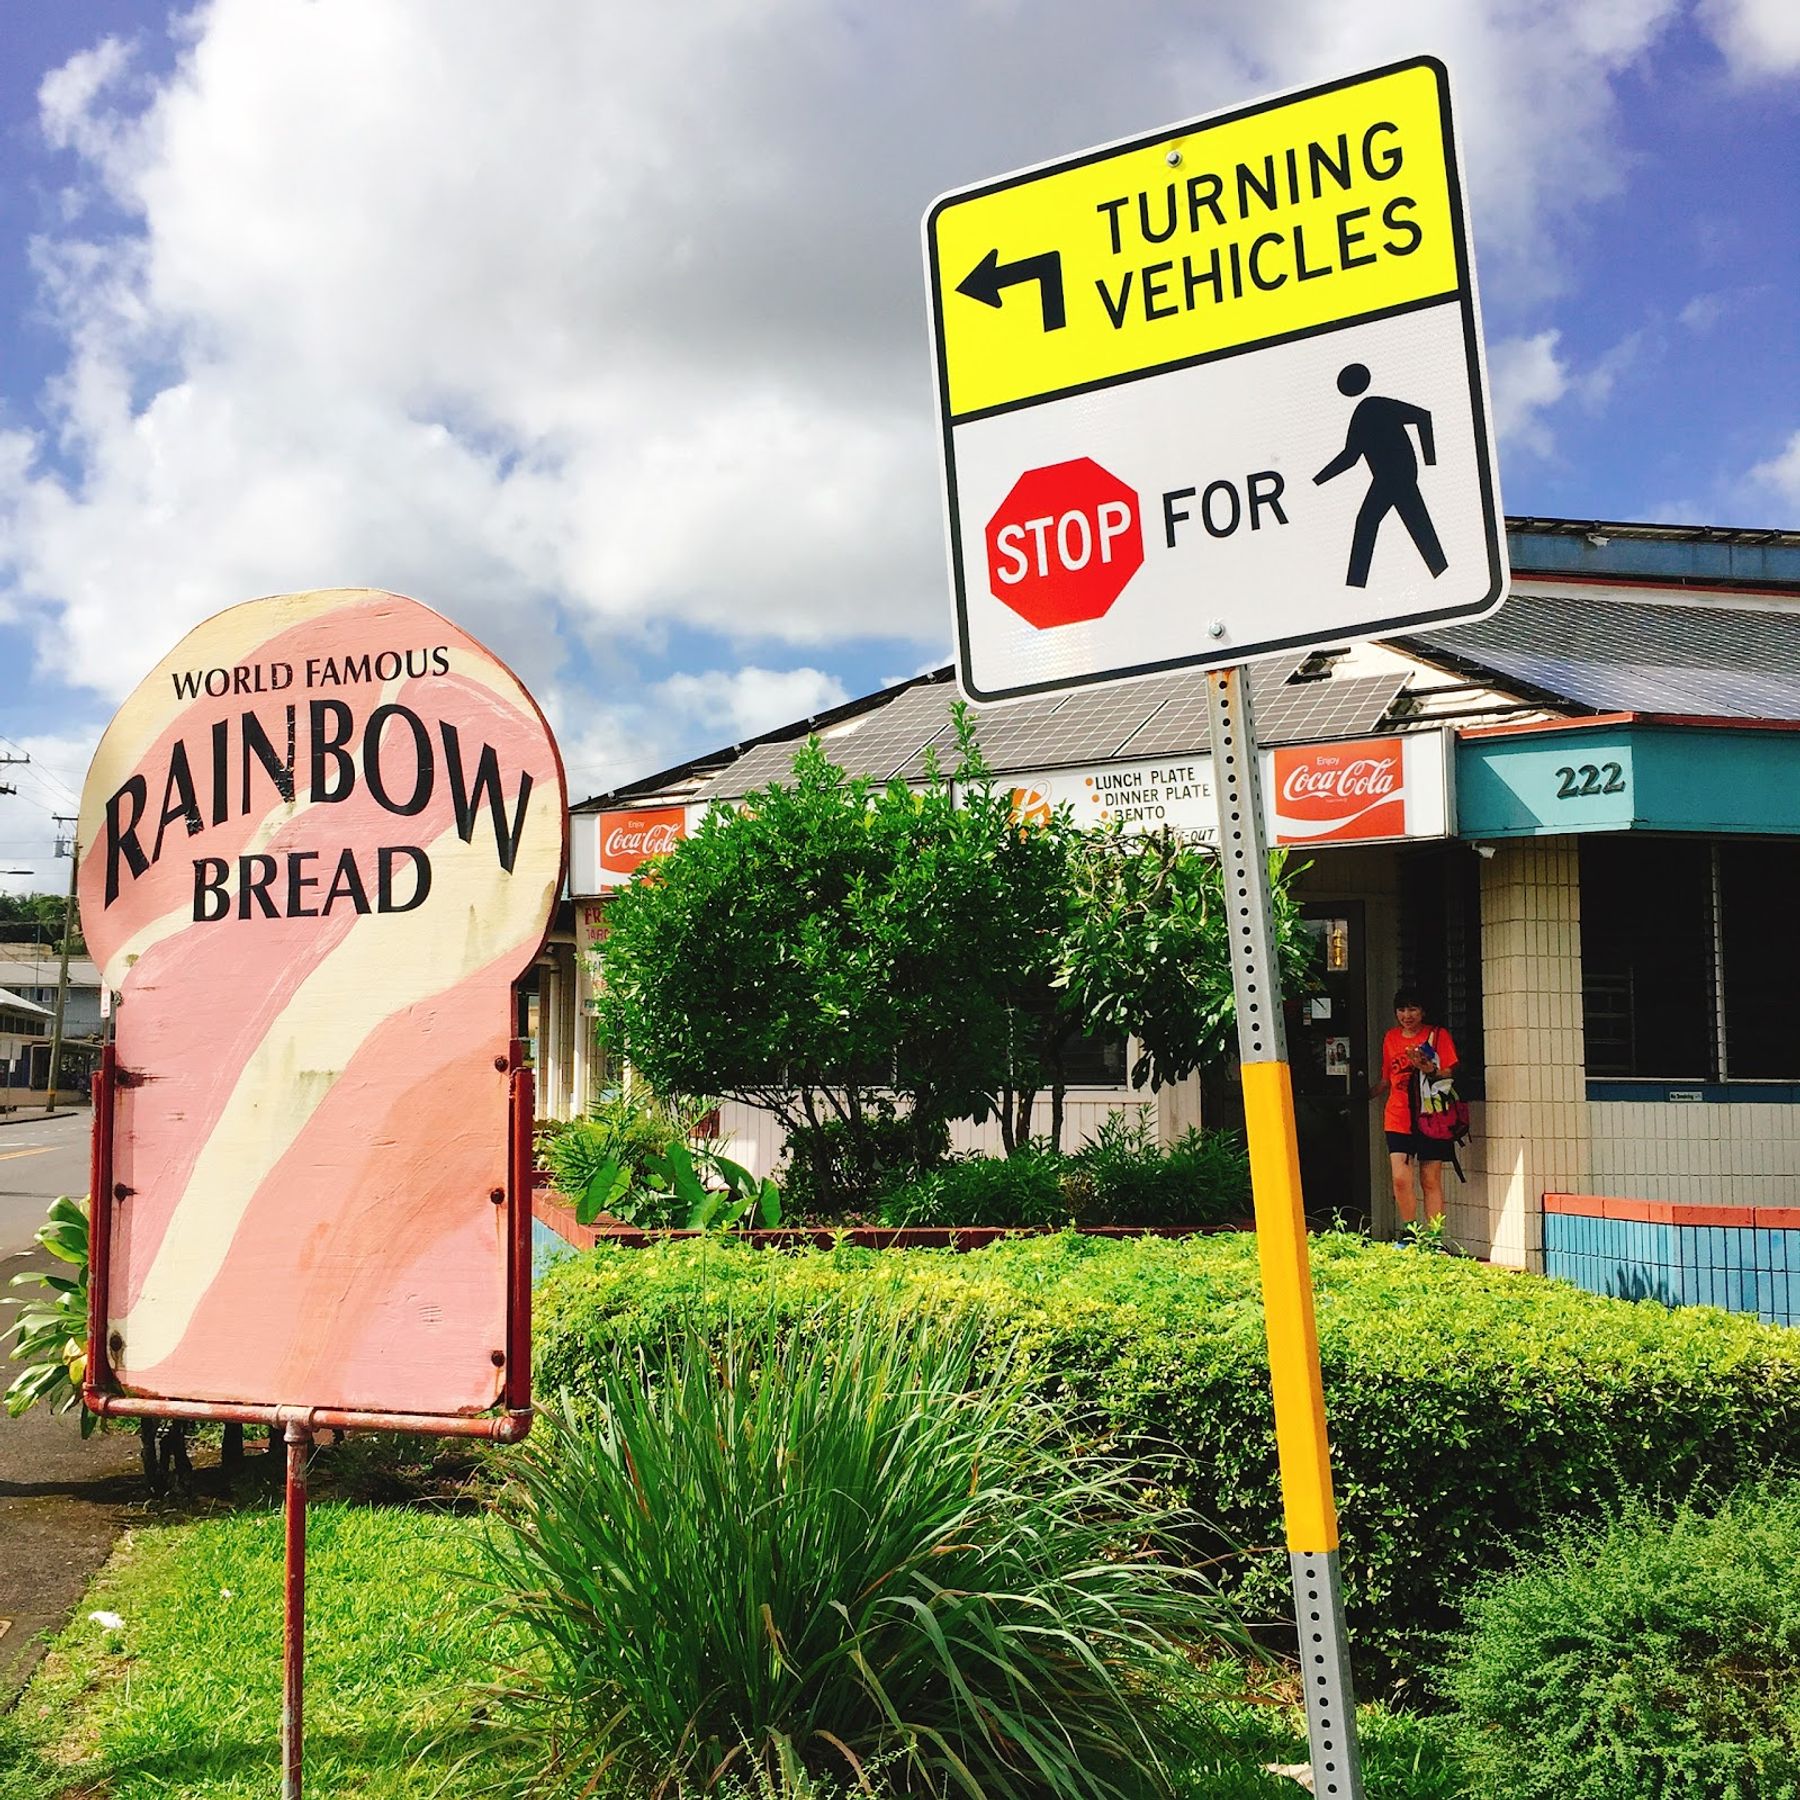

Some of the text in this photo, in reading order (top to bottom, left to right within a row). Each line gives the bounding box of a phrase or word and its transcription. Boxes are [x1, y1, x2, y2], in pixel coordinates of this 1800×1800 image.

[1097, 122, 1403, 254] TURNING
[1095, 197, 1422, 330] VEHICLES
[997, 471, 1289, 585] STOP FOR
[172, 646, 449, 700] WORLD FAMOUS
[1095, 767, 1196, 790] LUNCH PLATE
[1283, 757, 1398, 801] Coca-Cola
[1317, 756, 1340, 766] Enjoy
[1555, 762, 1626, 799] 222
[105, 700, 533, 911] RAINBOW
[1105, 784, 1211, 806] DINNER PLATE
[1114, 806, 1165, 820] BENTO
[192, 846, 432, 922] BREAD
